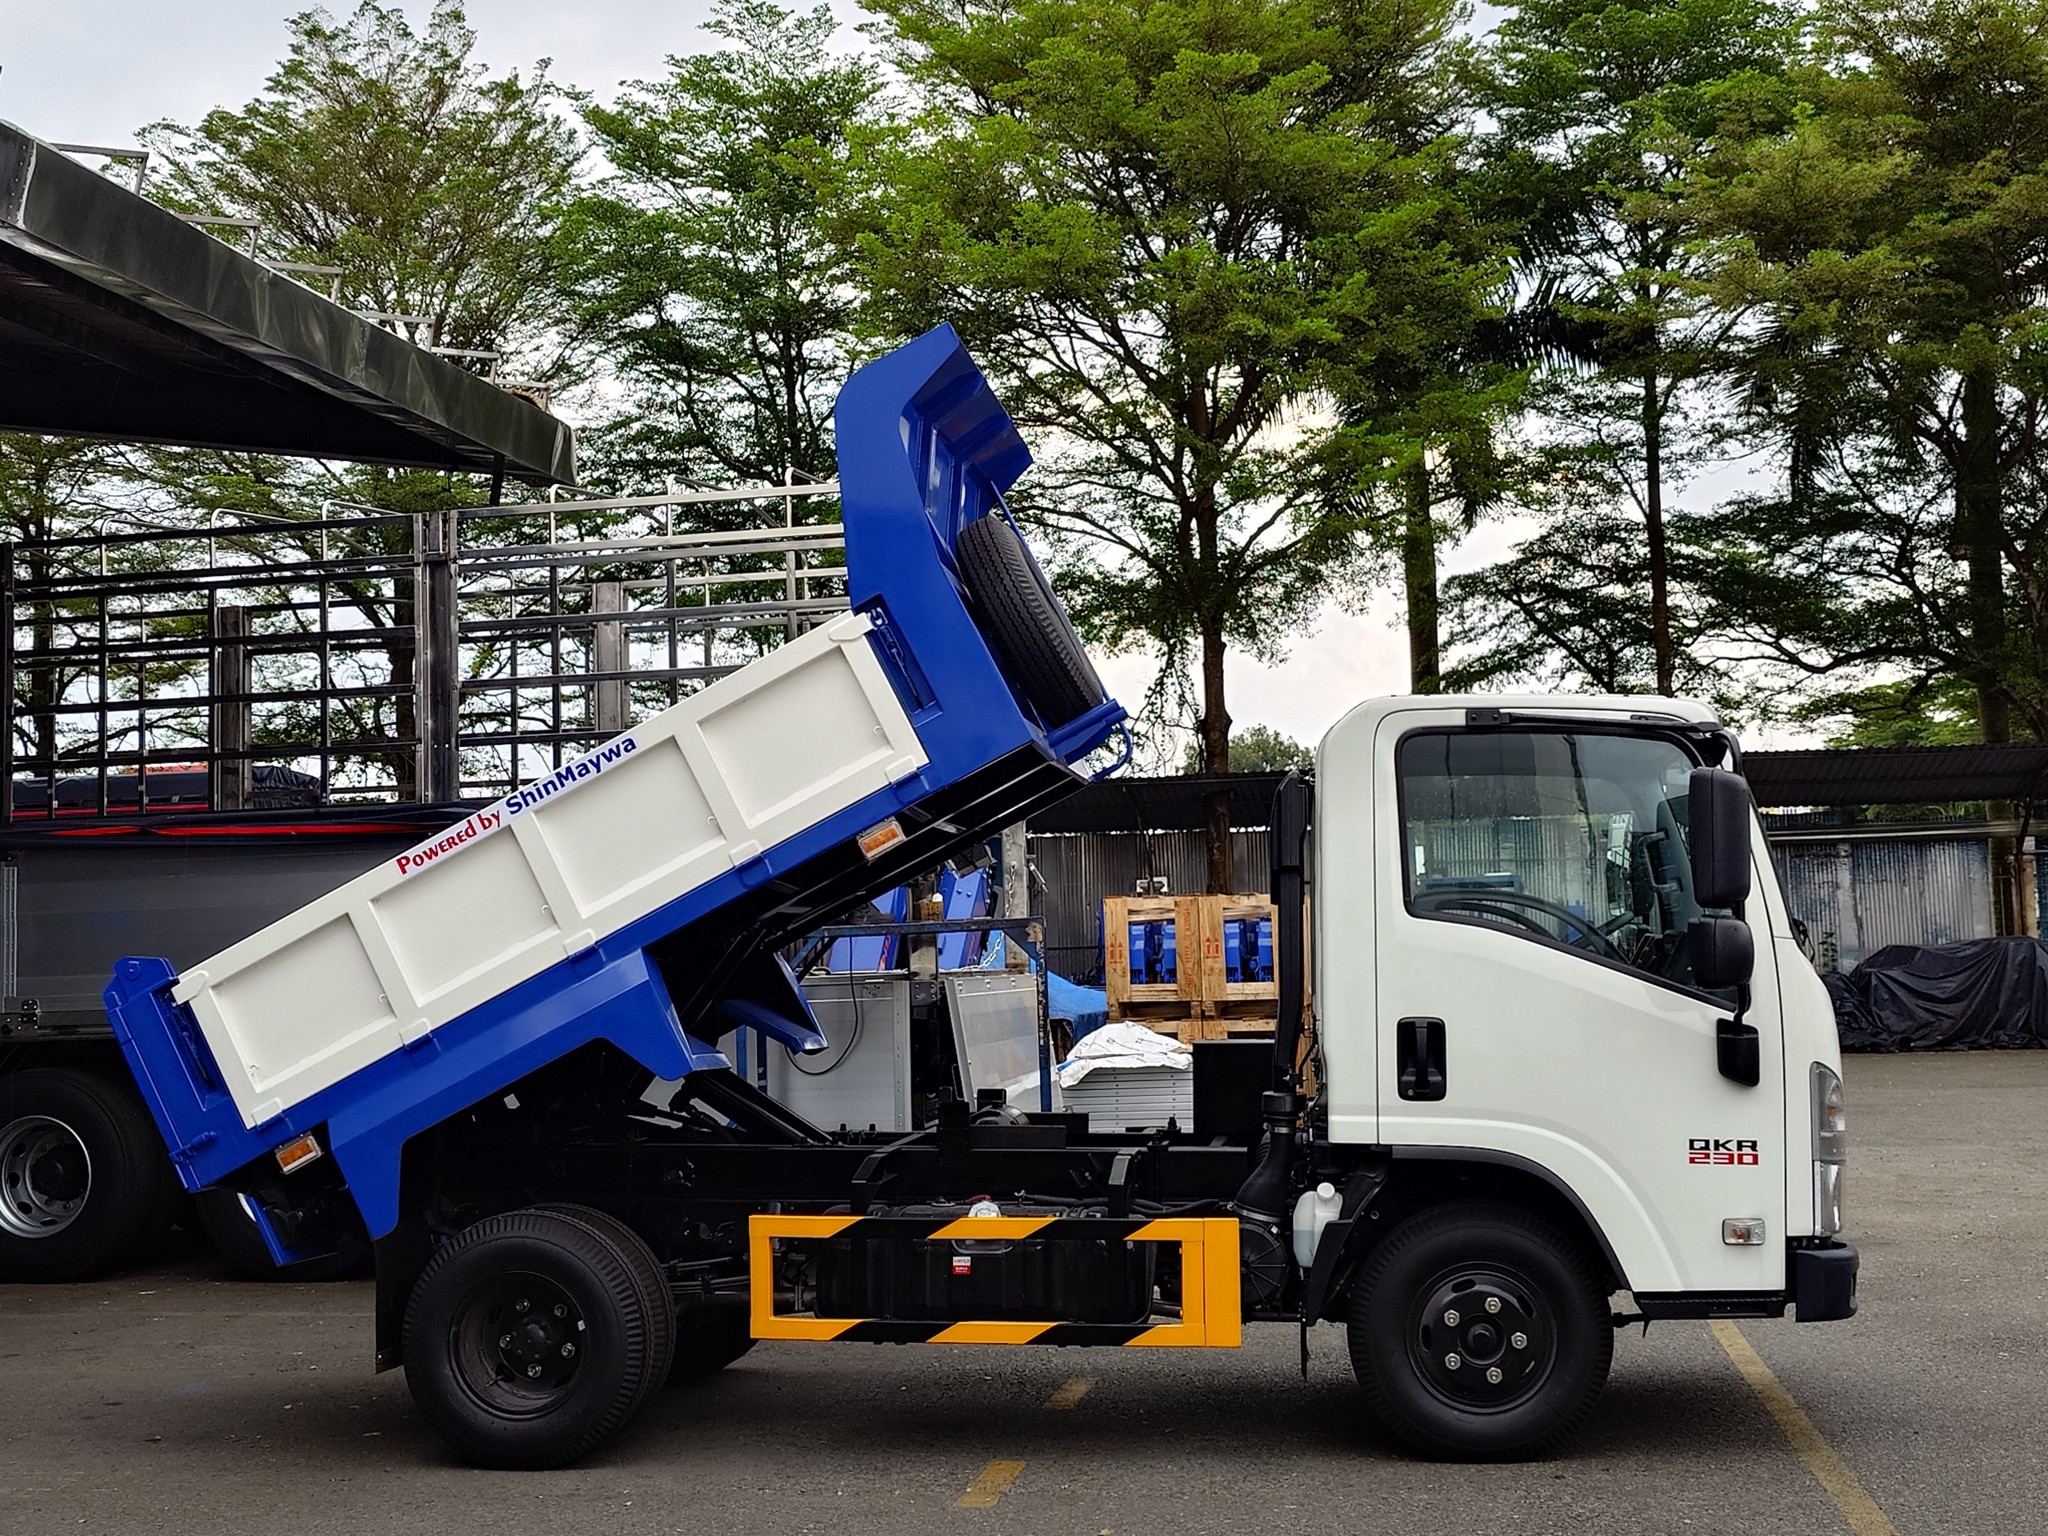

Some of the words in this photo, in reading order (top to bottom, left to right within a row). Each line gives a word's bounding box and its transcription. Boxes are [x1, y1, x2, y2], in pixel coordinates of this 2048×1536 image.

[477, 810, 501, 830] by
[506, 738, 638, 815] ShinMaywa
[1688, 1138, 1758, 1152] QKR
[1688, 1151, 1759, 1165] 230
